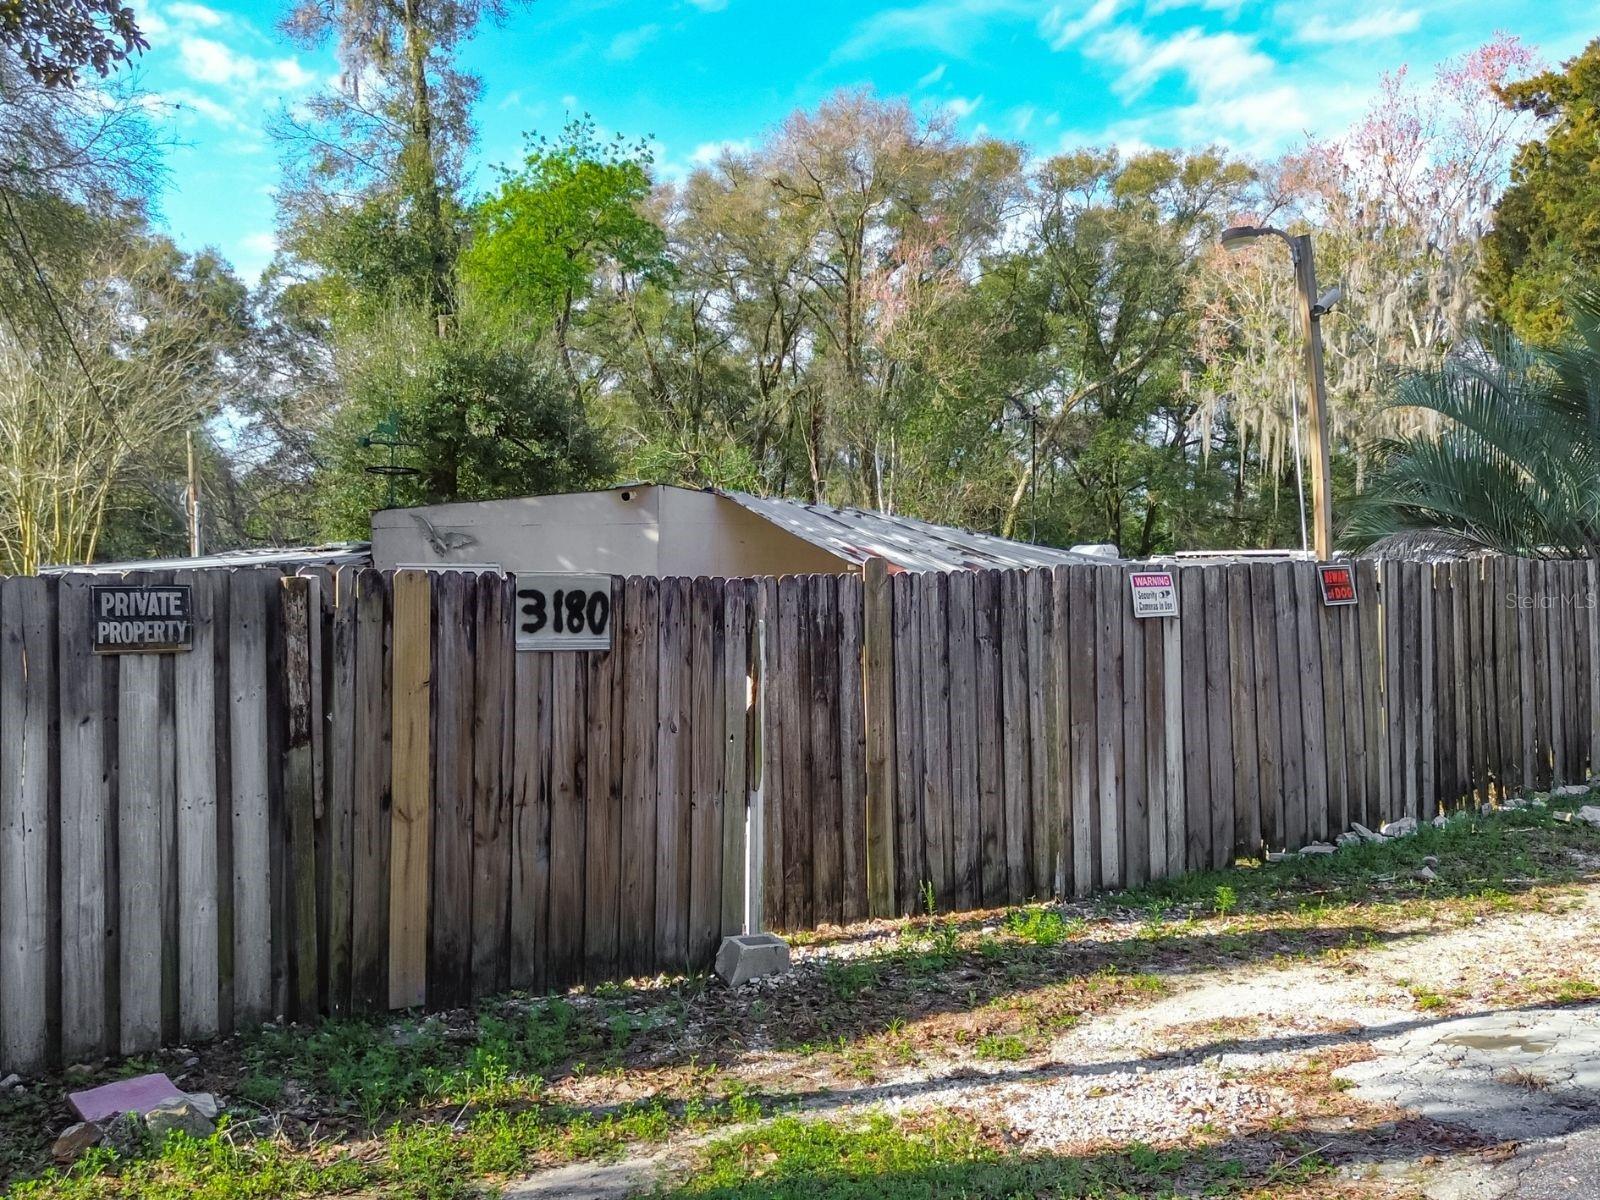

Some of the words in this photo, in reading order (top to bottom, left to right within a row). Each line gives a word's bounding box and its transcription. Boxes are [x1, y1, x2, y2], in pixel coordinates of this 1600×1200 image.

[1134, 576, 1169, 586] WARNING
[1137, 590, 1158, 601] Security
[1334, 587, 1353, 599] DOG
[101, 592, 182, 616] PRIVATE
[1139, 602, 1158, 611] Cameras
[1165, 601, 1173, 610] Use
[517, 589, 609, 635] 3180
[98, 621, 187, 644] PROPERTY
